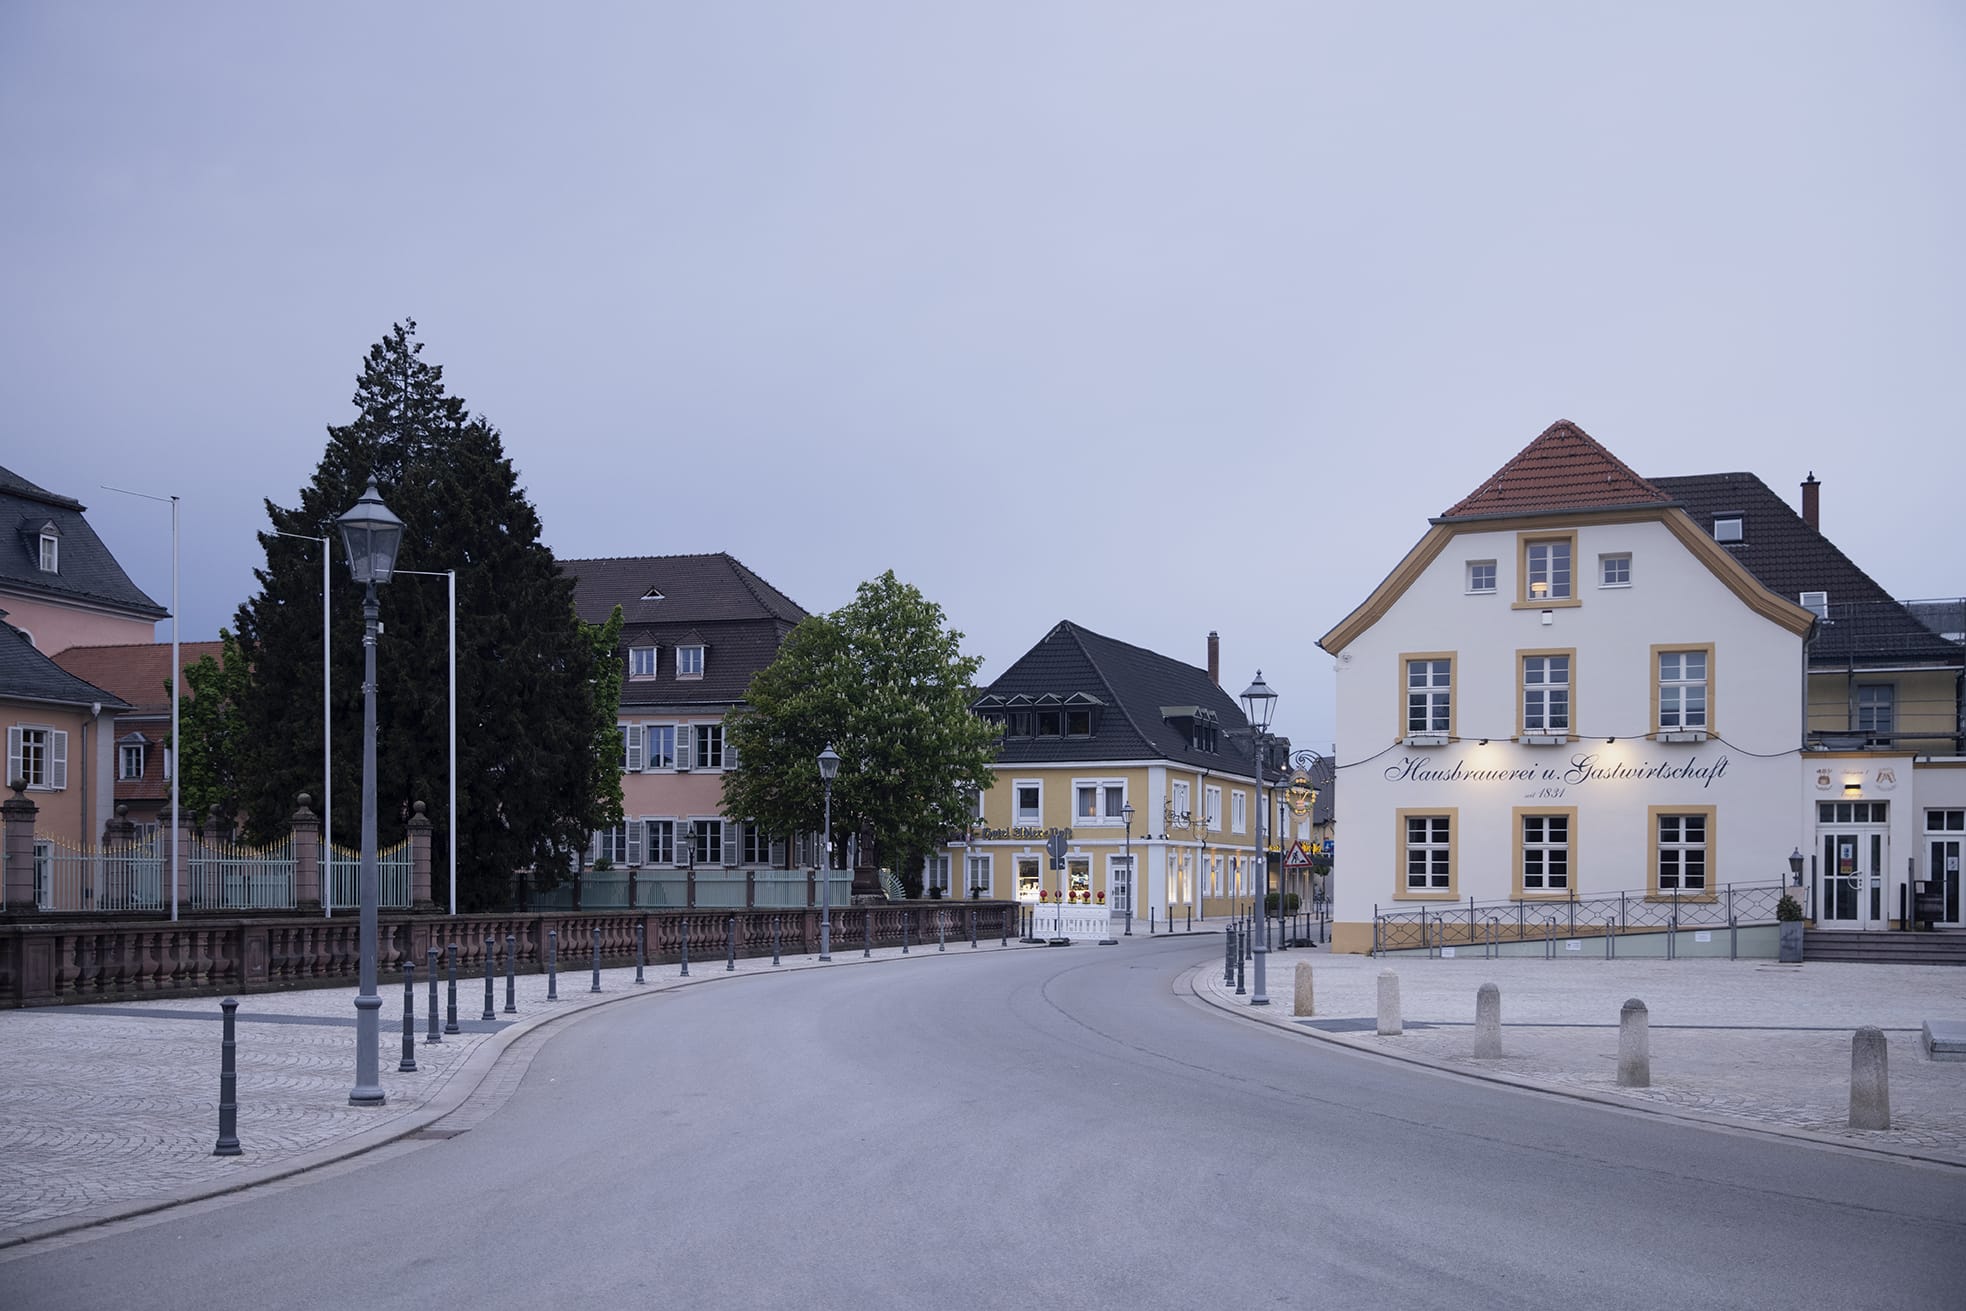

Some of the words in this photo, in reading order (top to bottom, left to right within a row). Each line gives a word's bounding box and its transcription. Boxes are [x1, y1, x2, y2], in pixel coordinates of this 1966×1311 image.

[1384, 757, 1537, 782] Hausbrauerei
[1542, 767, 1560, 780] u.
[1564, 753, 1729, 788] Gastwirtschaft
[1539, 787, 1566, 798] 1831
[983, 827, 1010, 840] Hotel
